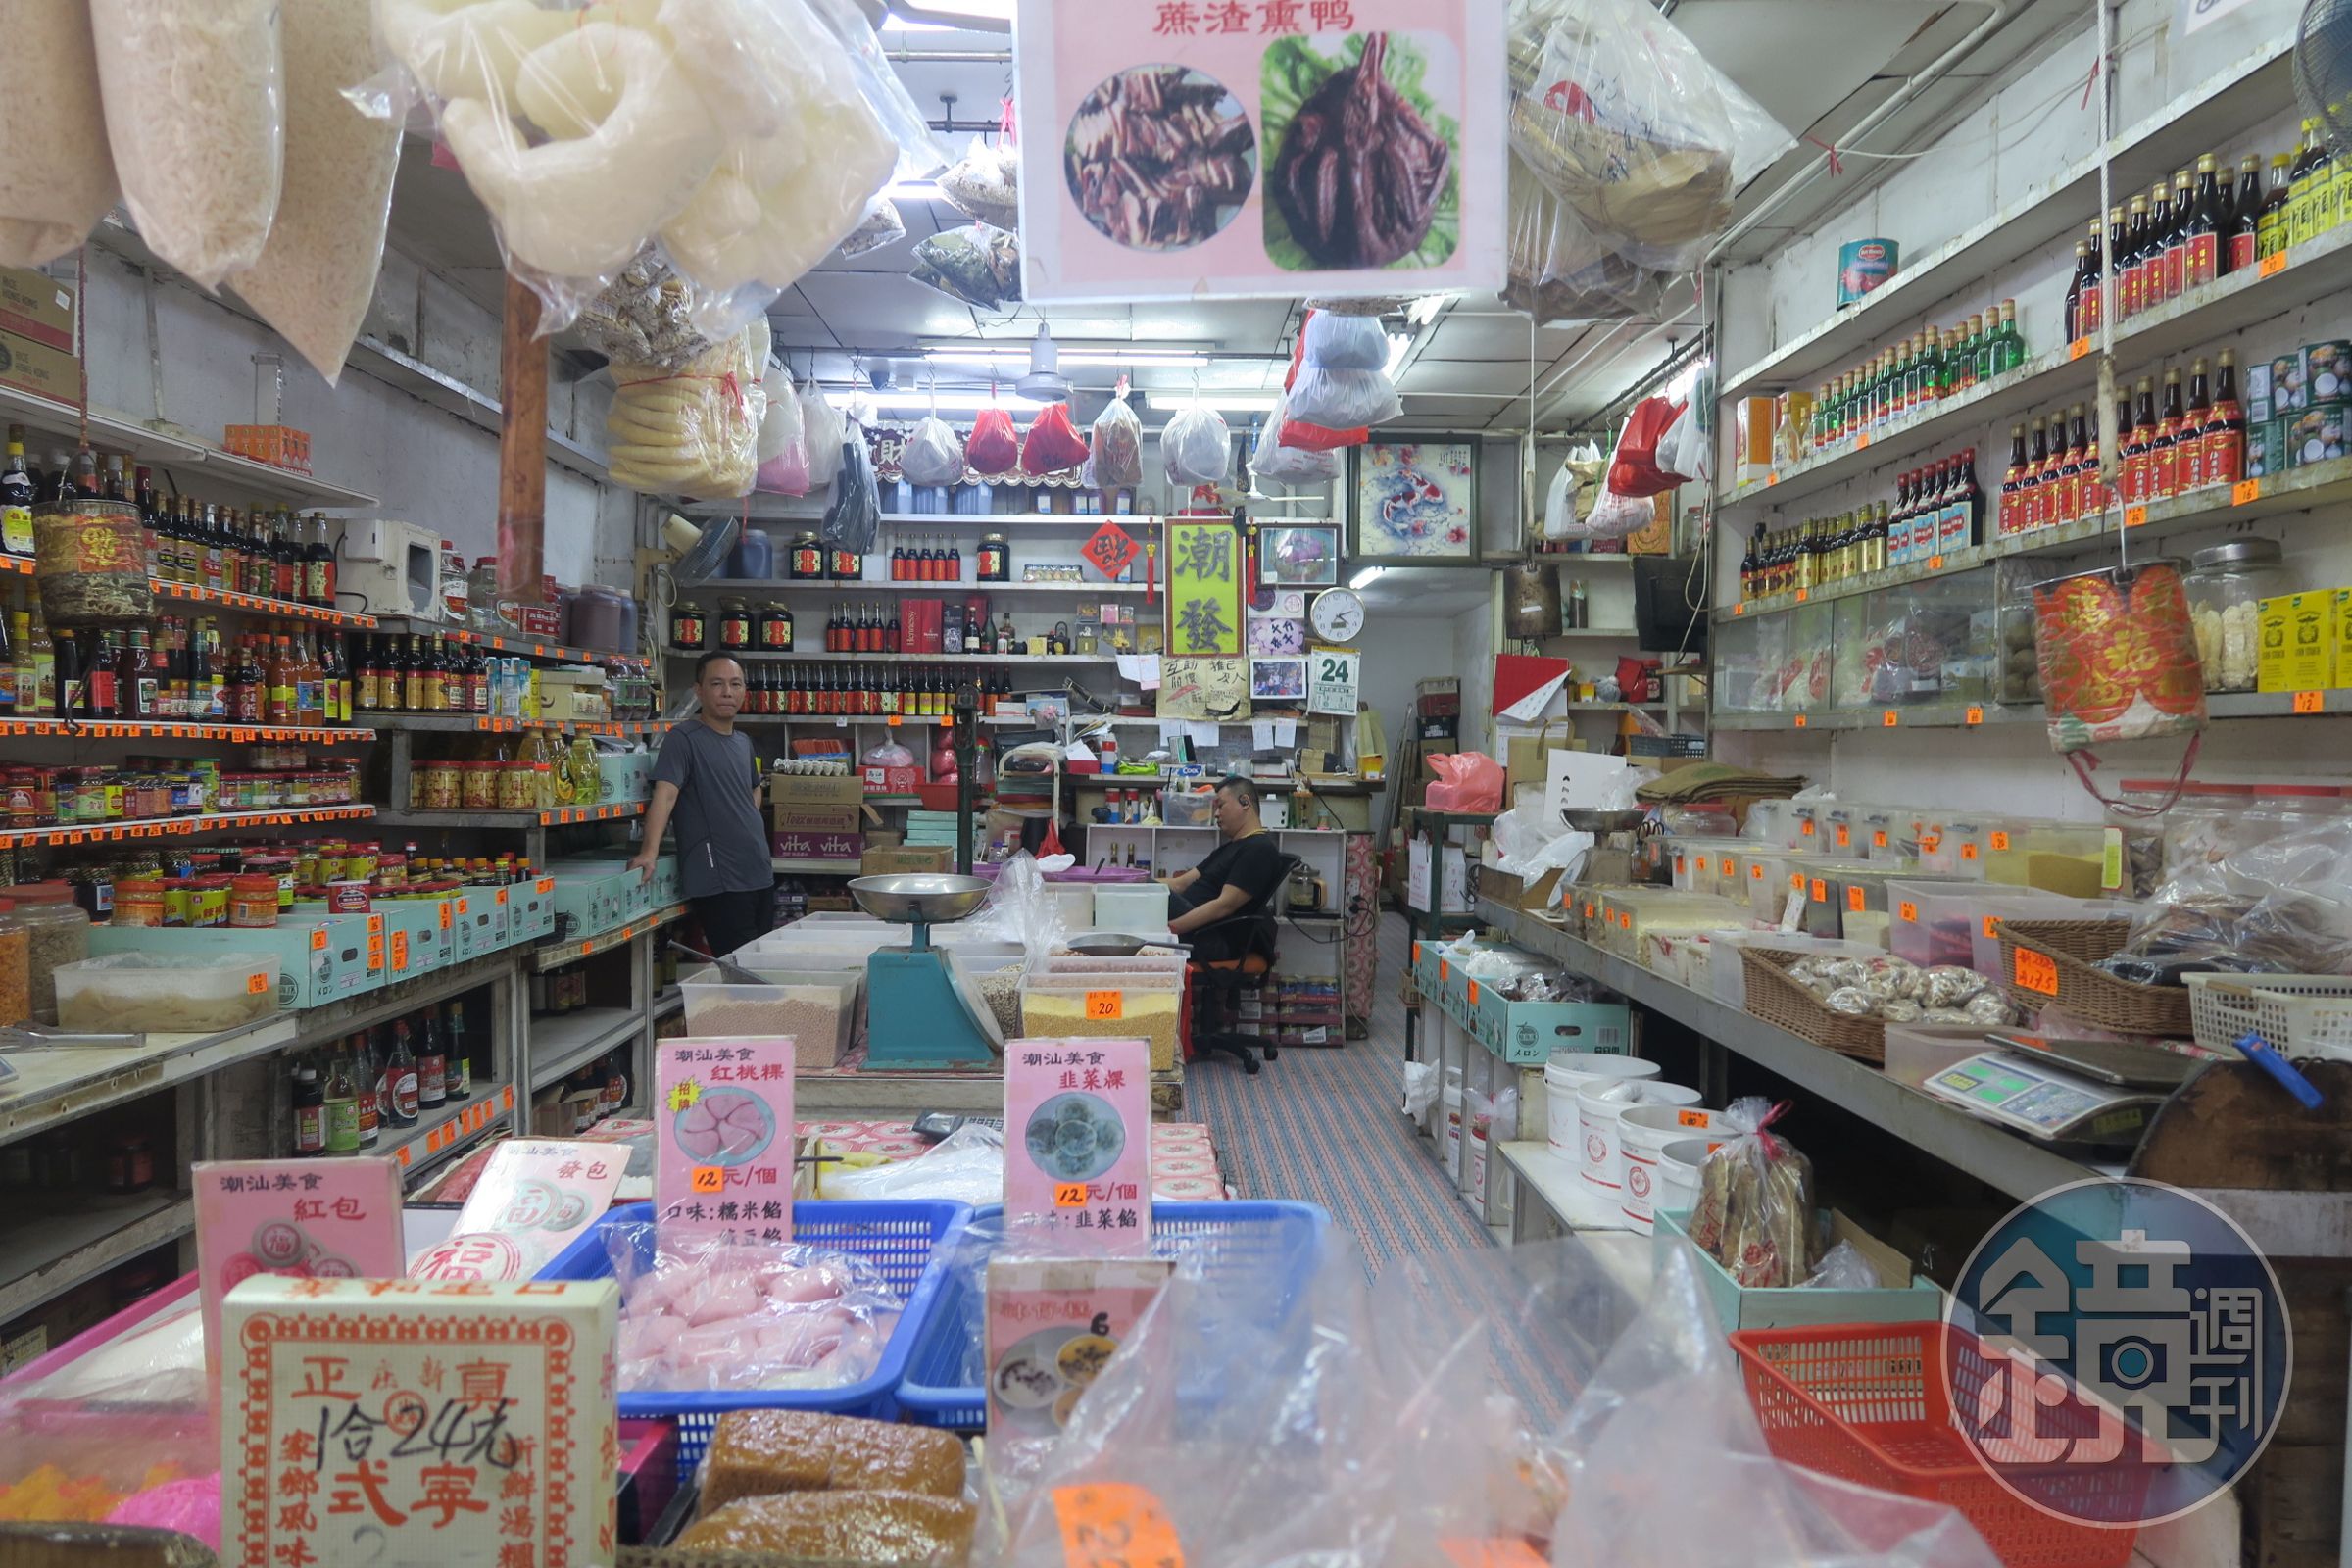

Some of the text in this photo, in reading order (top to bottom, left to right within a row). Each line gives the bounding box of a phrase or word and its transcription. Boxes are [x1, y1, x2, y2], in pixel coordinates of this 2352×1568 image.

[1174, 526, 1233, 652] 潮發
[1321, 658, 1348, 682] 24
[780, 835, 810, 852] vita
[820, 835, 851, 852] vita
[675, 1049, 755, 1061] 潮汕美食
[1022, 1053, 1105, 1066] 潮汕美食
[1515, 1049, 1540, 1057] メロン
[678, 1082, 690, 1110] 招牌
[557, 1162, 607, 1180] 發包
[698, 1172, 717, 1186] 12
[723, 1166, 777, 1187] 元/個
[220, 1174, 323, 1192] 潮汕美食
[1086, 1182, 1137, 1201] 元/個
[1059, 1188, 1083, 1202] 12
[294, 1197, 367, 1222] 紅包
[425, 1239, 491, 1279] 福
[1090, 1311, 1110, 1337] 6
[274, 1429, 319, 1568] 家鄉風味
